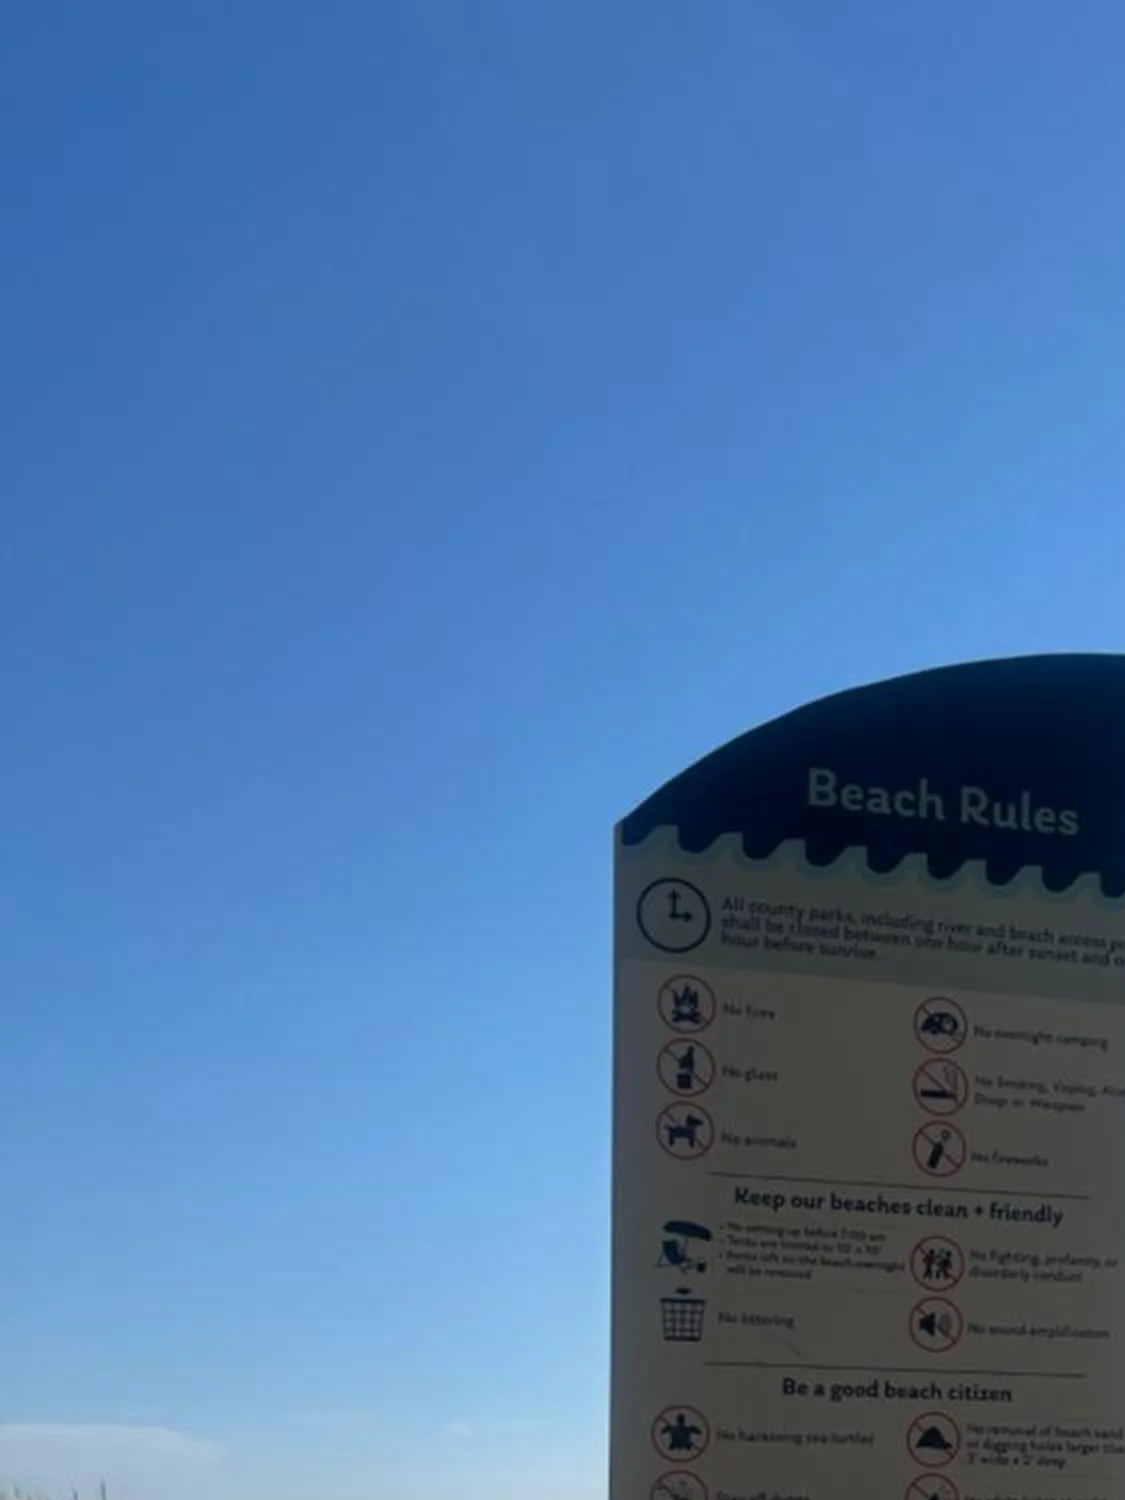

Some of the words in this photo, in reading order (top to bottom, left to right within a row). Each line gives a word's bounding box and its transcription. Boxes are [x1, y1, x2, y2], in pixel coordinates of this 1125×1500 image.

[808, 767, 946, 820] Beach
[960, 785, 1079, 835] Rules
[722, 898, 744, 912] All
[749, 901, 803, 922] county
[810, 906, 856, 923] parks,
[861, 912, 934, 934] including
[937, 920, 971, 933] river
[976, 923, 1004, 938] and
[1010, 925, 1054, 943] beach
[1058, 934, 1106, 949] access
[722, 915, 760, 929] shall
[766, 918, 784, 932] be
[790, 920, 840, 937] closed
[845, 927, 911, 944] between
[915, 937, 943, 949] one
[949, 936, 981, 951] hour
[987, 941, 1024, 956] after
[1029, 946, 1078, 962] sunset
[1082, 951, 1110, 967] and
[722, 931, 758, 947] hour
[765, 934, 813, 953] before
[723, 1001, 742, 1016] No
[974, 1024, 991, 1038] No
[722, 1066, 741, 1079] No
[744, 1067, 778, 1082] glass
[721, 1131, 740, 1146] No
[971, 1150, 989, 1163] No
[735, 1187, 786, 1213] Keep
[791, 1194, 825, 1210] our
[830, 1192, 911, 1215] beaches
[916, 1198, 968, 1218] clean
[974, 1206, 983, 1215] +
[989, 1201, 1063, 1229] friendly
[970, 1250, 986, 1260] No
[717, 1312, 737, 1324] No
[967, 1323, 985, 1334] No
[782, 1378, 810, 1395] Be
[813, 1382, 825, 1396] a
[830, 1380, 878, 1401] good
[884, 1380, 943, 1400] beach
[948, 1383, 1012, 1402] citizen
[717, 1430, 735, 1440] No
